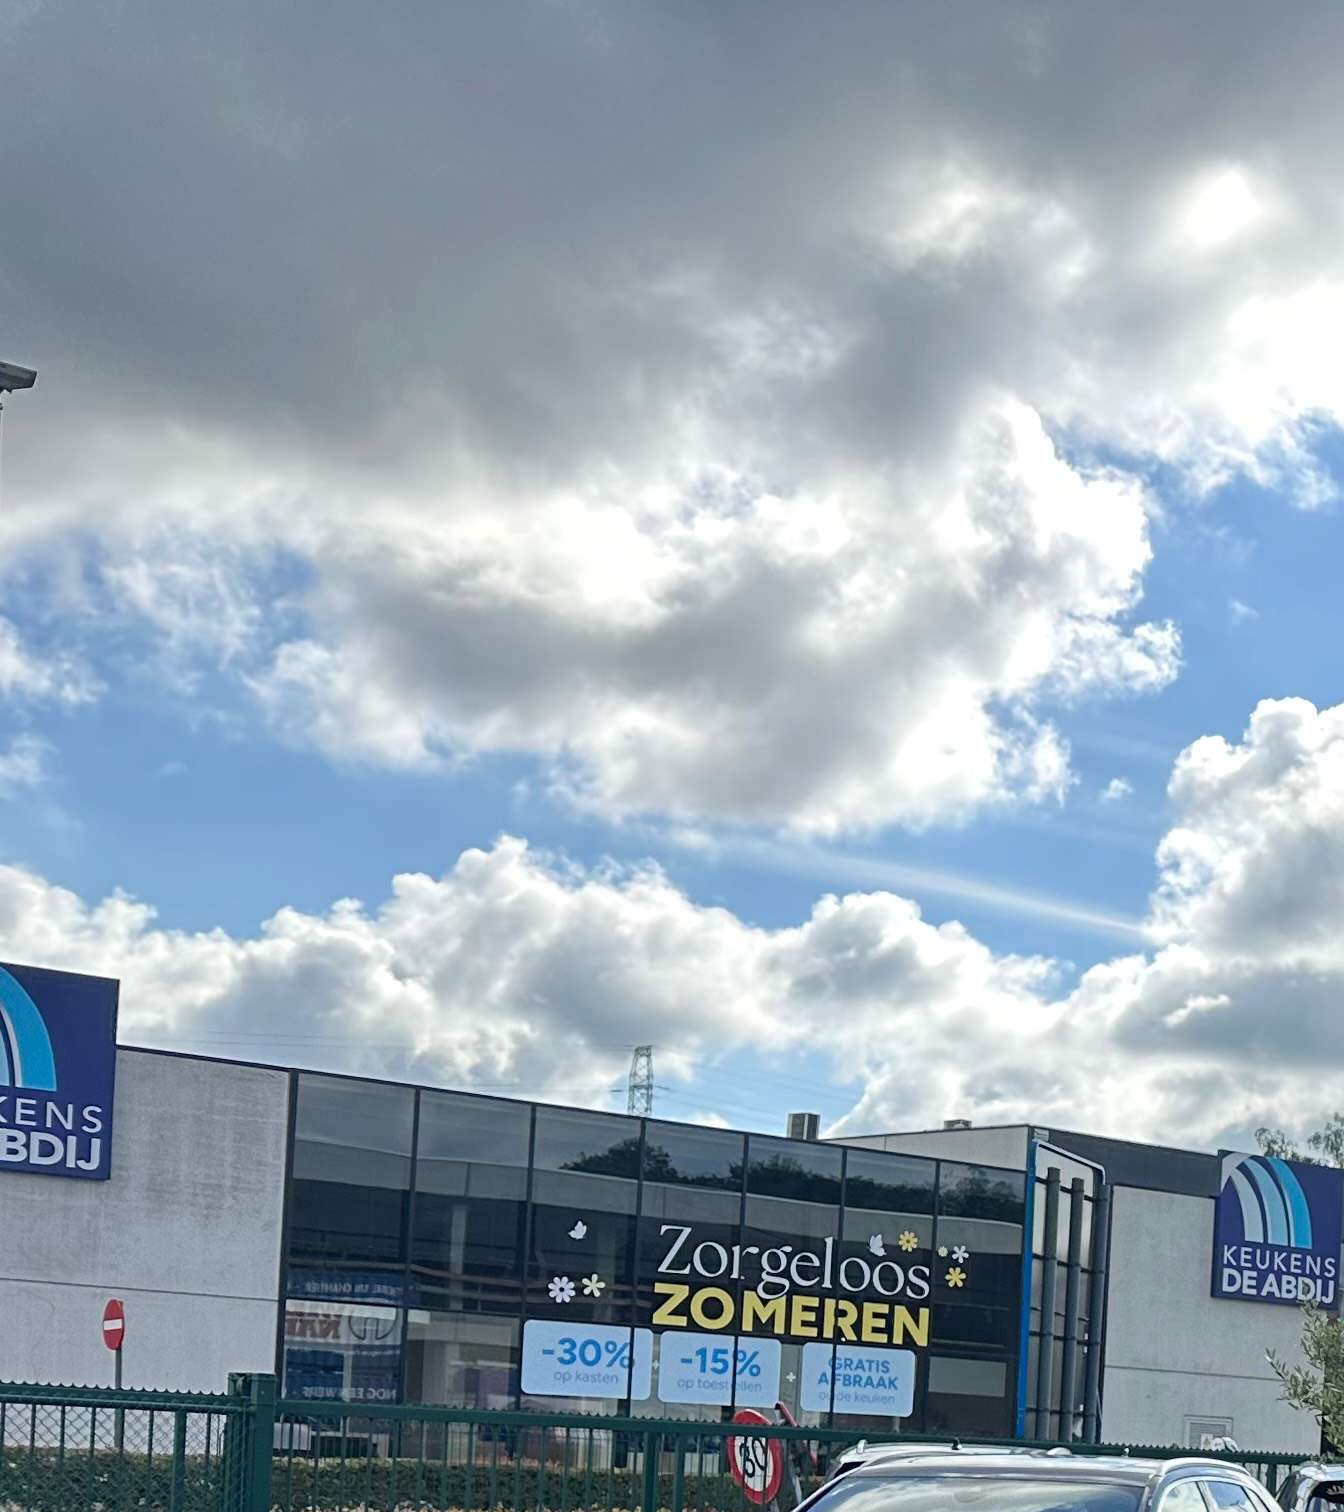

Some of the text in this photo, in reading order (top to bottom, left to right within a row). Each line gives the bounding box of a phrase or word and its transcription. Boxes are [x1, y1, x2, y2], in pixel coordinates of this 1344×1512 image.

[657, 1224, 931, 1300] Zorgeloos
[1223, 1244, 1336, 1278] KEUKENS
[1222, 1267, 1335, 1304] DE ABDIJ
[652, 1281, 930, 1348] ZOMEREN
[542, 1337, 634, 1370] -30%
[680, 1346, 761, 1377] -15%
[828, 1356, 891, 1374] GRATIS
[553, 1371, 619, 1385] op kasten
[817, 1371, 899, 1391] AFBRAAK
